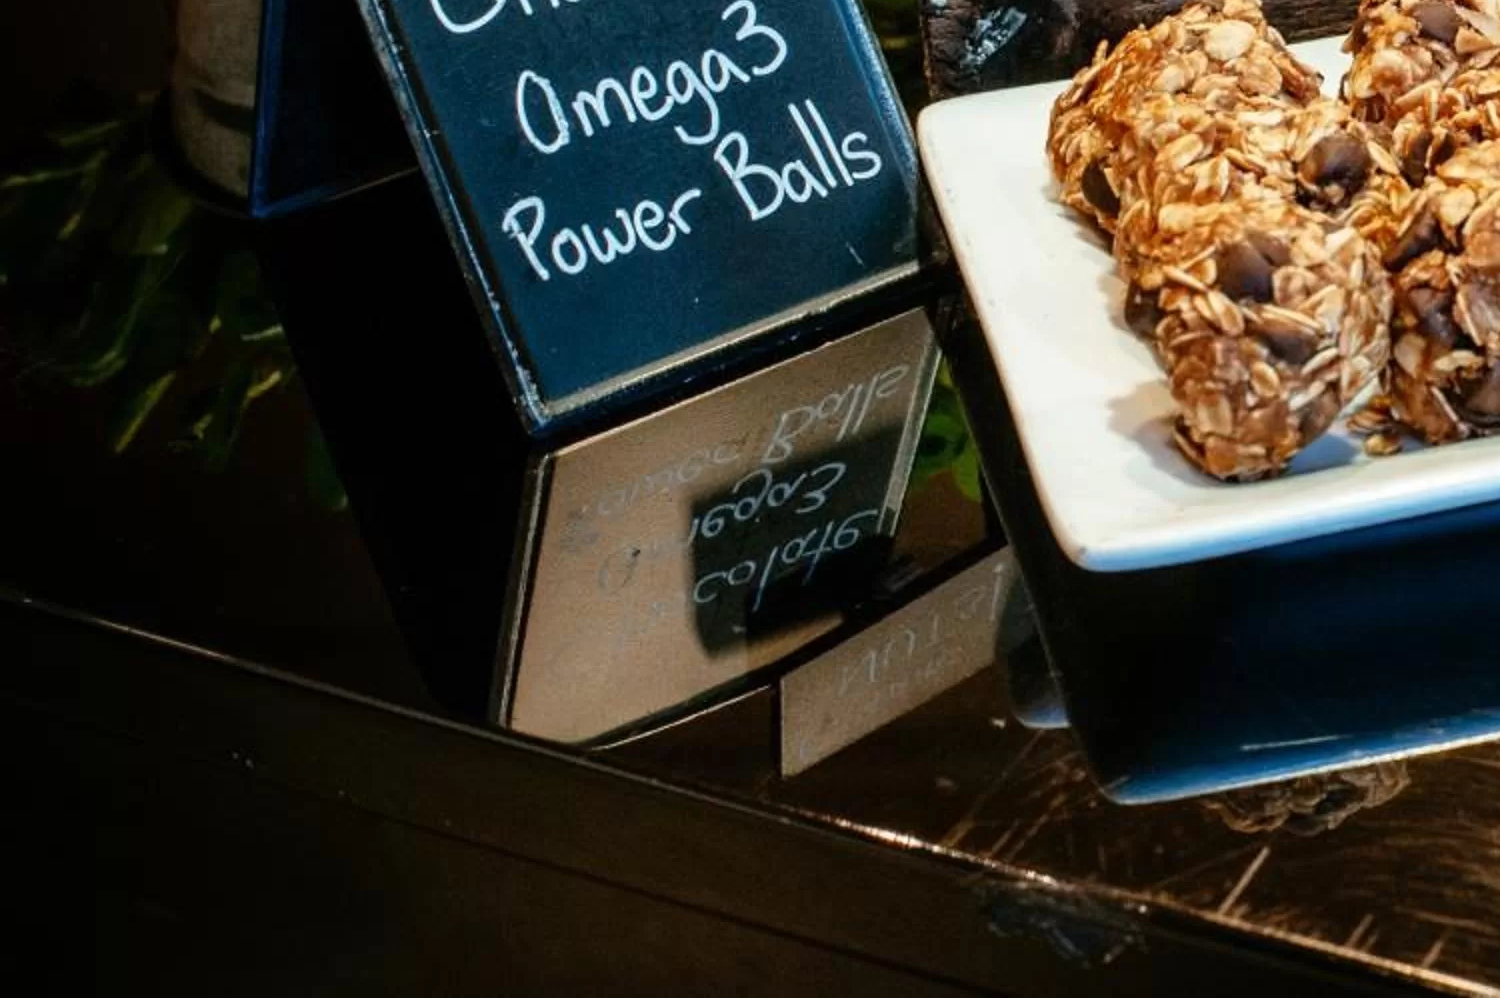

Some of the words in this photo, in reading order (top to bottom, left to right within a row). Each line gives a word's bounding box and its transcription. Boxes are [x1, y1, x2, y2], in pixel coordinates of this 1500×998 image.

[516, 0, 788, 154] Omega3
[502, 189, 701, 281] Power
[714, 100, 882, 221] Balls
